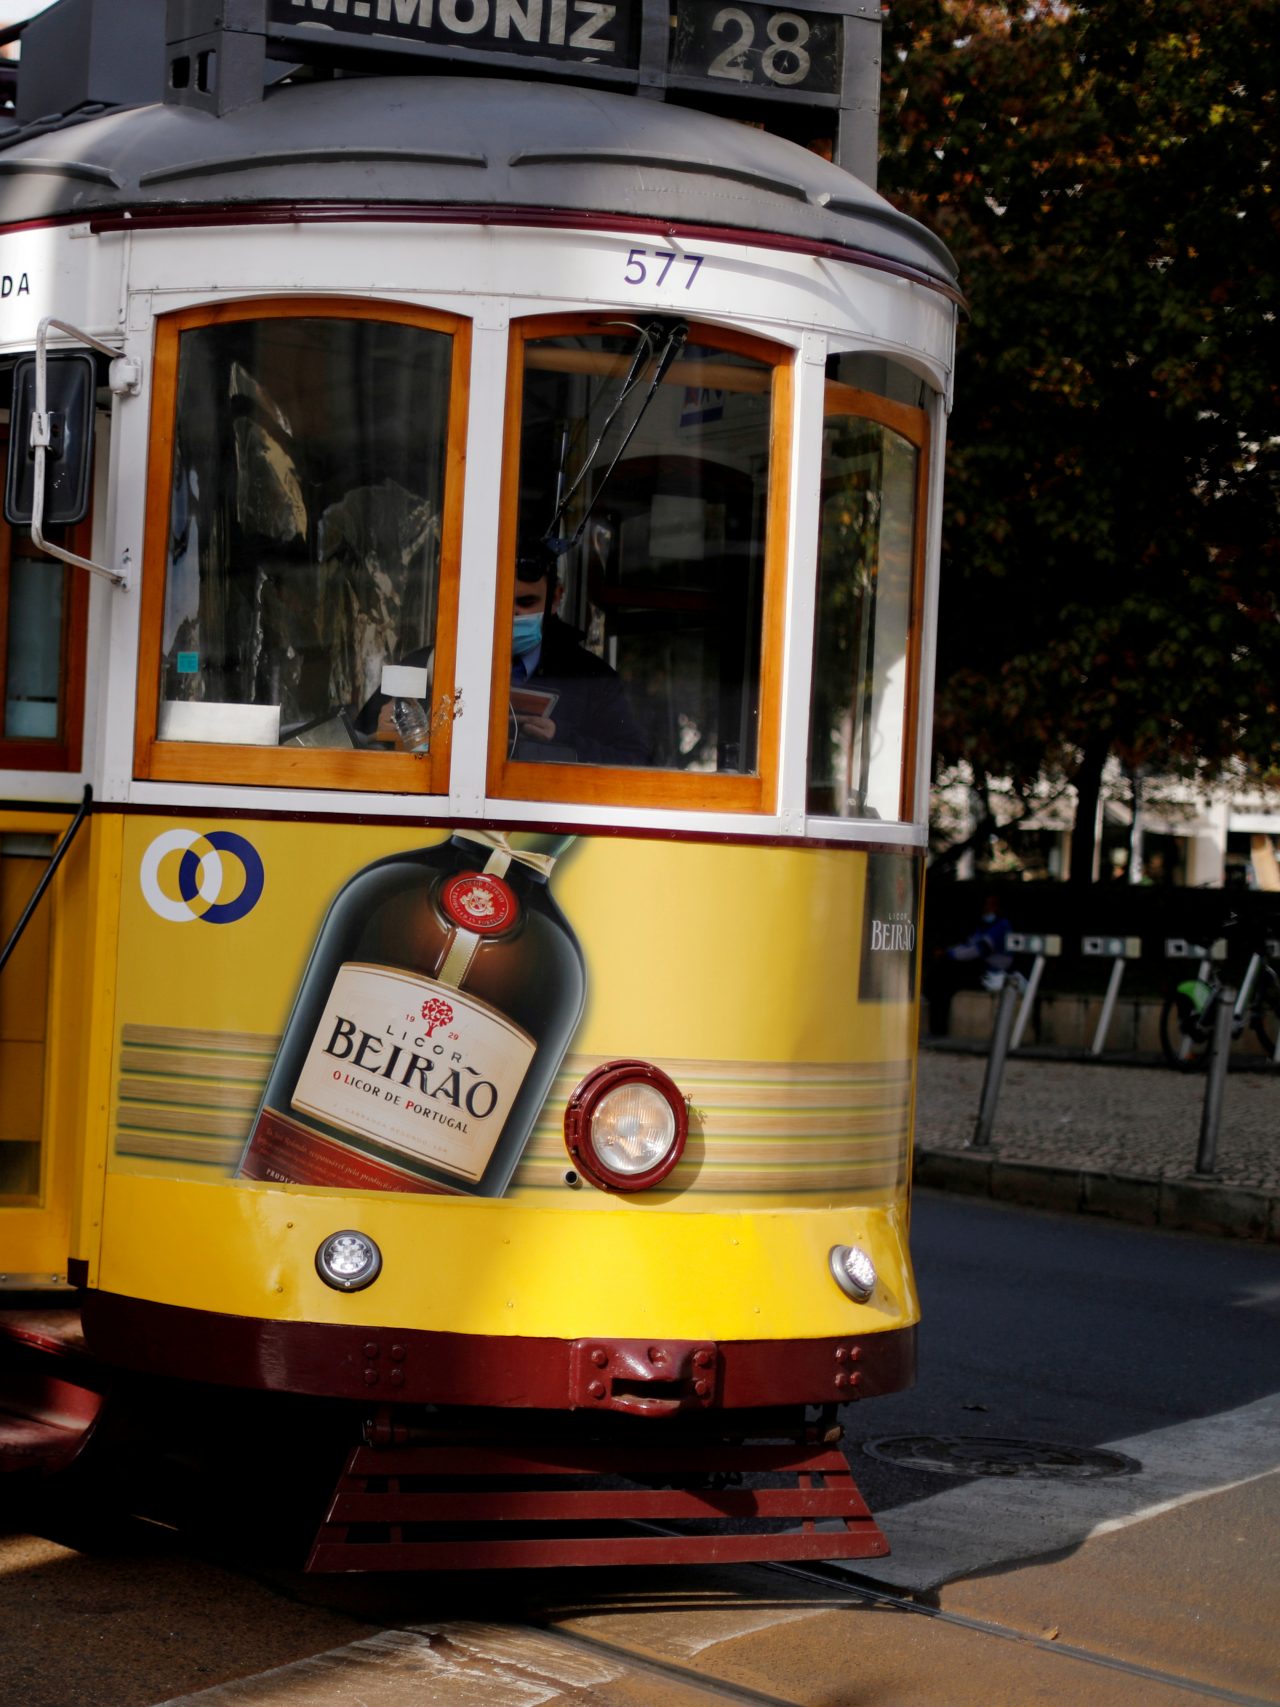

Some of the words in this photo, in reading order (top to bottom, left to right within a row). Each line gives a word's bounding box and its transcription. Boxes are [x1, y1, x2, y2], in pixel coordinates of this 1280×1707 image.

[290, 0, 617, 52] .MONIZ
[708, 8, 810, 86] 28
[623, 248, 705, 290] 577
[870, 919, 915, 952] BEIRÃO
[386, 1024, 463, 1064] LICOR
[405, 1013, 416, 1023] 19
[448, 1031, 460, 1041] 29
[321, 1014, 499, 1119] BEIRÃO
[333, 1070, 342, 1081] O
[344, 1071, 381, 1097] LICOR
[384, 1091, 400, 1106] DE
[404, 1099, 469, 1135] PORTUGAL
